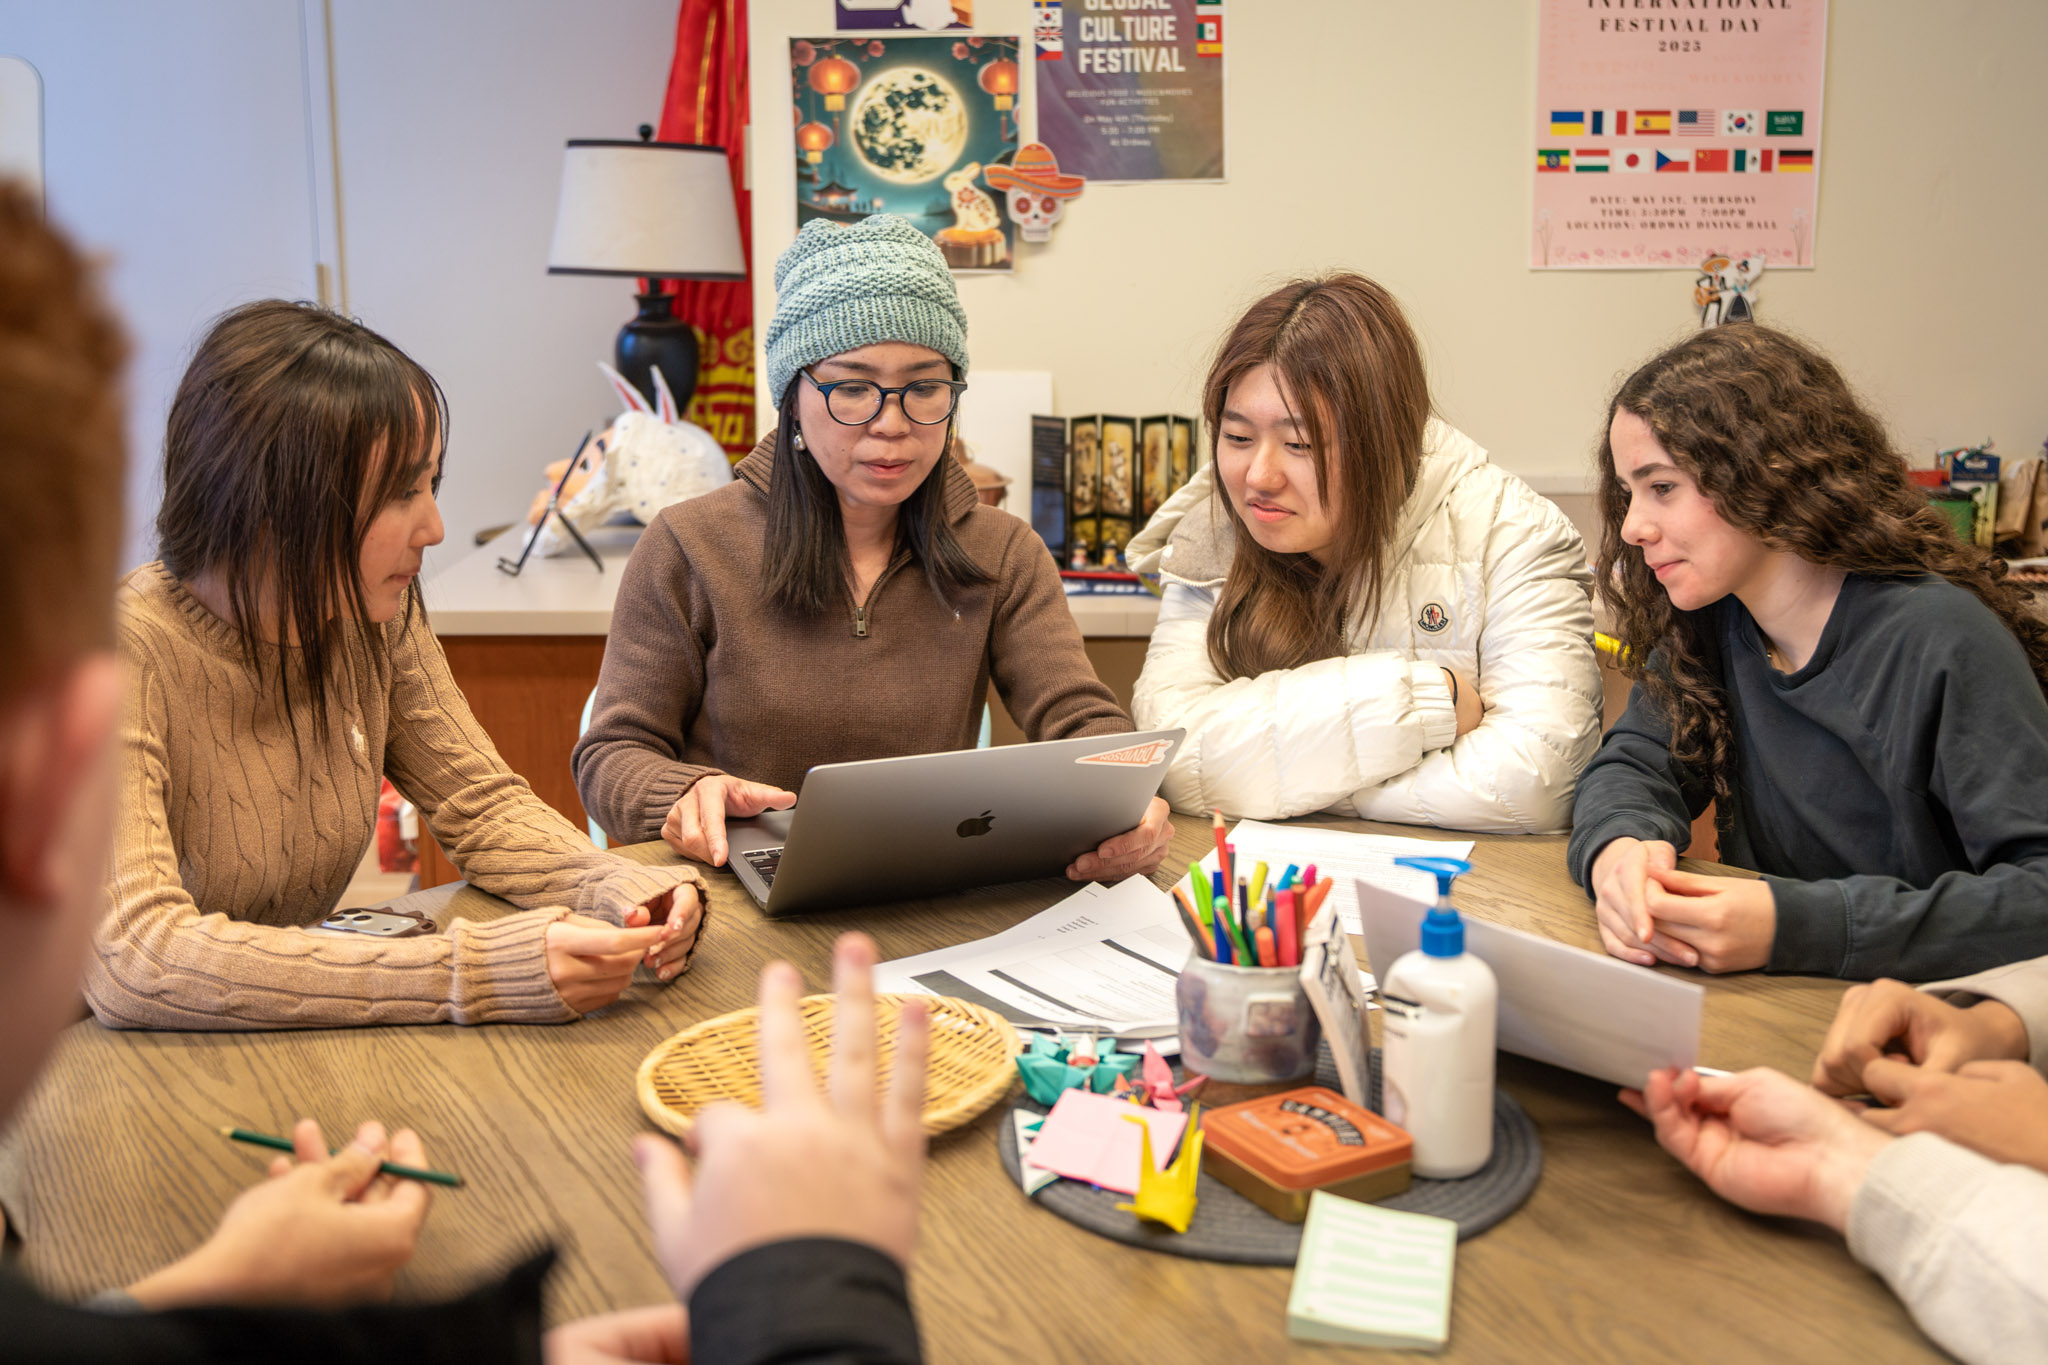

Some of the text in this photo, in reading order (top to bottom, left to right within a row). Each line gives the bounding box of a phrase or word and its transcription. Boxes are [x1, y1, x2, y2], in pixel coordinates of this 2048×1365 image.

[1079, 16, 1177, 42] CULTURE
[1599, 18, 1761, 33] FESTIVAL DAY
[1078, 47, 1186, 73] FESTIVAL
[1590, 196, 1627, 205] DATE:
[1632, 196, 1655, 204] MAY
[1692, 196, 1756, 204] THURSDAY
[1601, 208, 1636, 217] TIME:
[1566, 221, 1777, 230] LOCATION: ORDWAY DINING HALL
[1100, 746, 1153, 762] DAVIDSON
